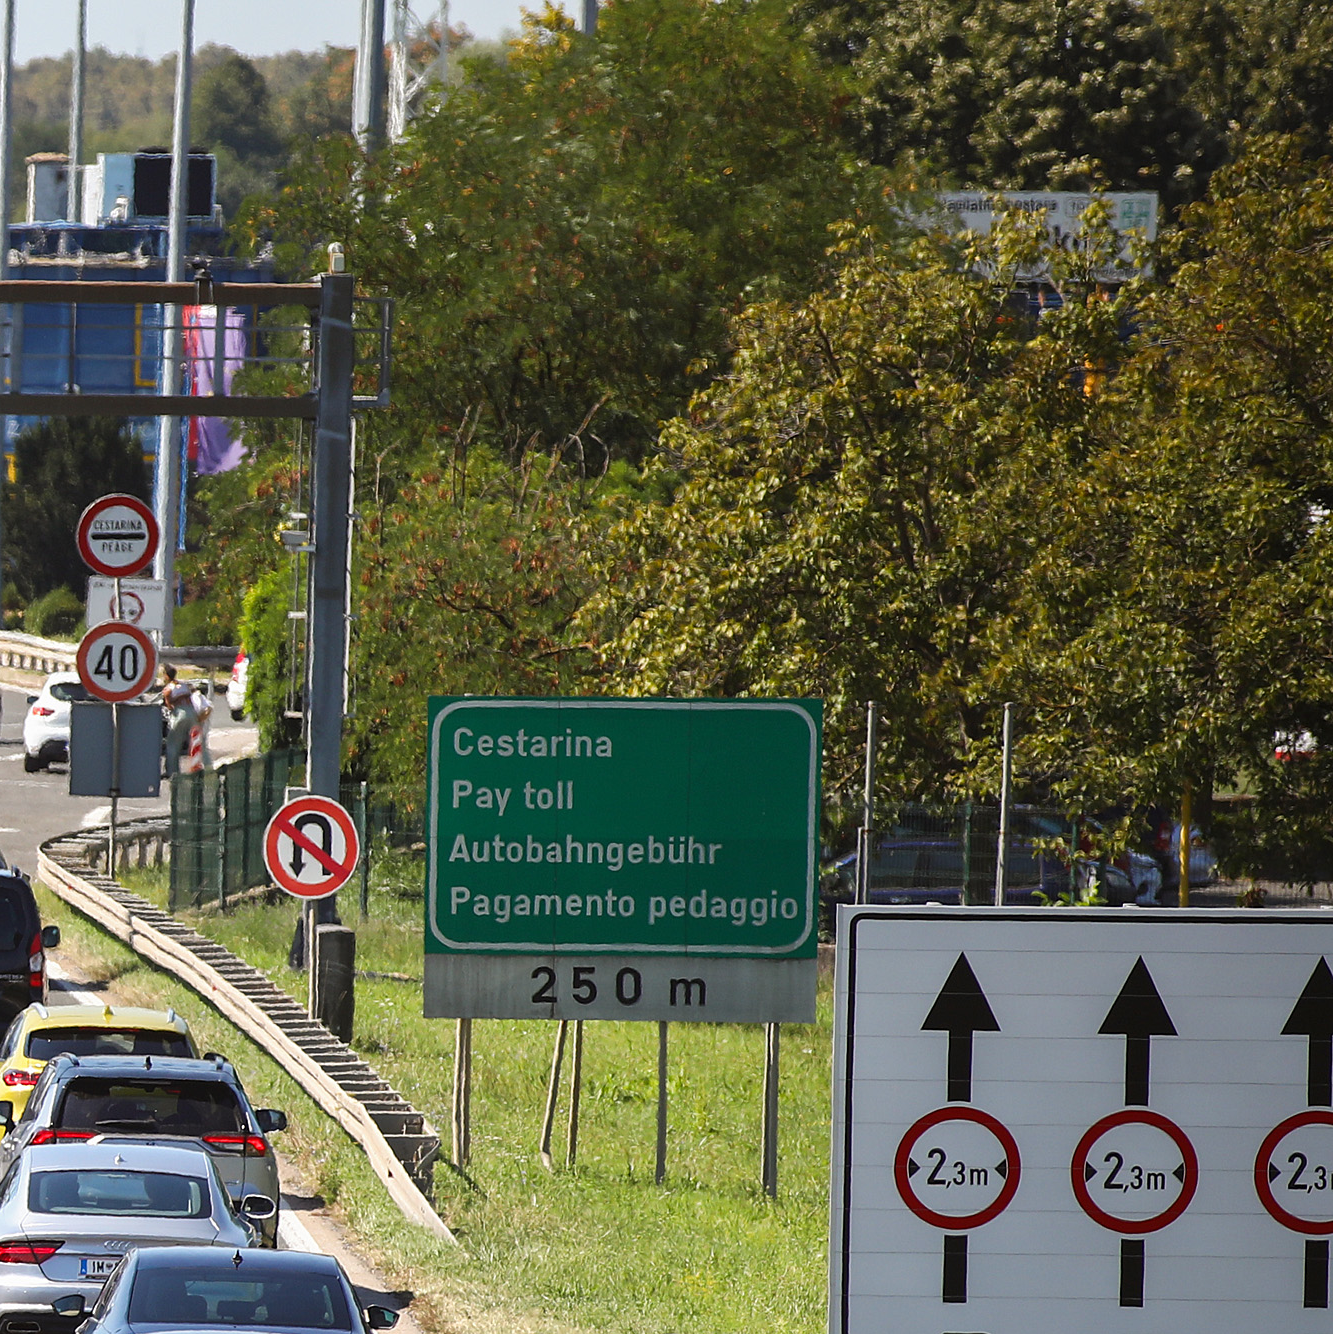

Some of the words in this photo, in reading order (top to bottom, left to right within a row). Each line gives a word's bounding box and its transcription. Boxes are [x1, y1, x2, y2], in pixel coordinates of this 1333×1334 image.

[94, 520, 143, 530] CESTARINA
[94, 645, 139, 682] 40
[453, 727, 613, 759] Cestarina
[451, 779, 512, 816] Pay
[524, 780, 574, 810] toll
[449, 834, 723, 872] Autobahngebühr
[449, 886, 635, 923] Pagamento
[648, 889, 799, 926] pedaggio
[531, 965, 643, 1005] 250
[669, 977, 708, 1007] m
[1286, 1152, 1333, 1195] 2,3
